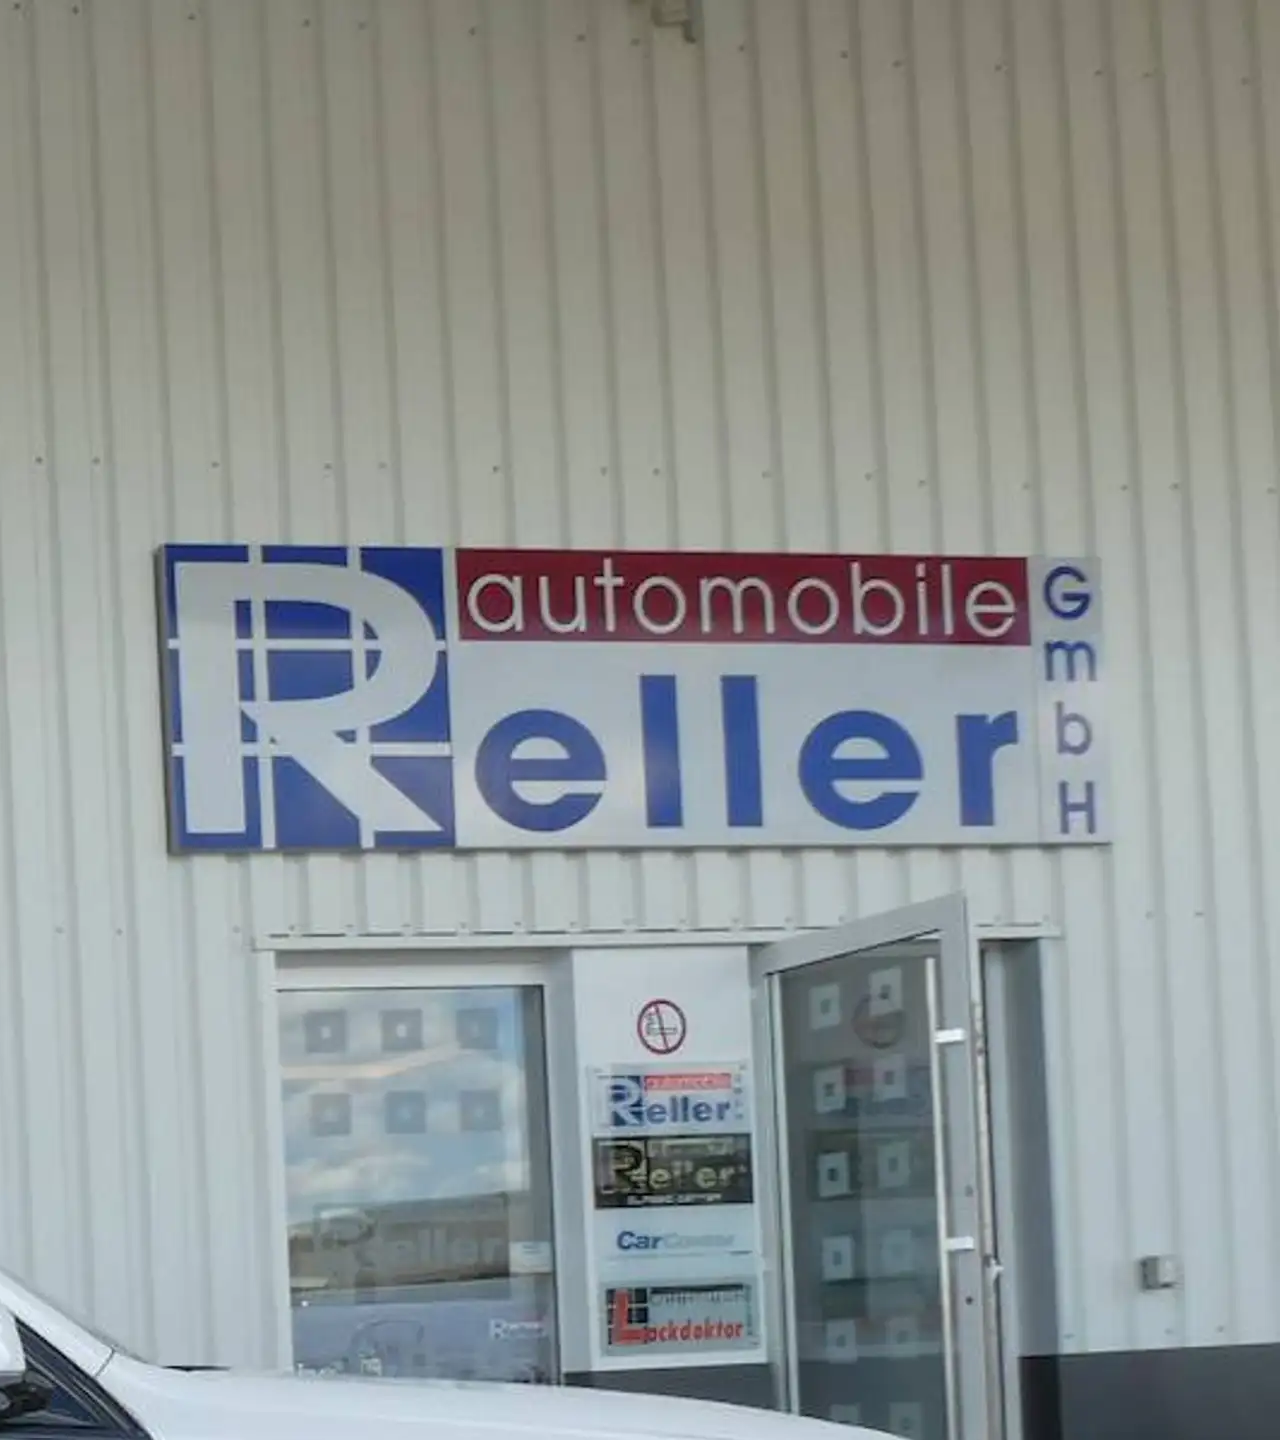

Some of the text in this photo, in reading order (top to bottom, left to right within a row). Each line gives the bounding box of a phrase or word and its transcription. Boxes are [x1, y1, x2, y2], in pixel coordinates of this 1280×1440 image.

[467, 557, 1018, 637] automobile
[175, 560, 1021, 834] Reller
[600, 1076, 732, 1127] Reller
